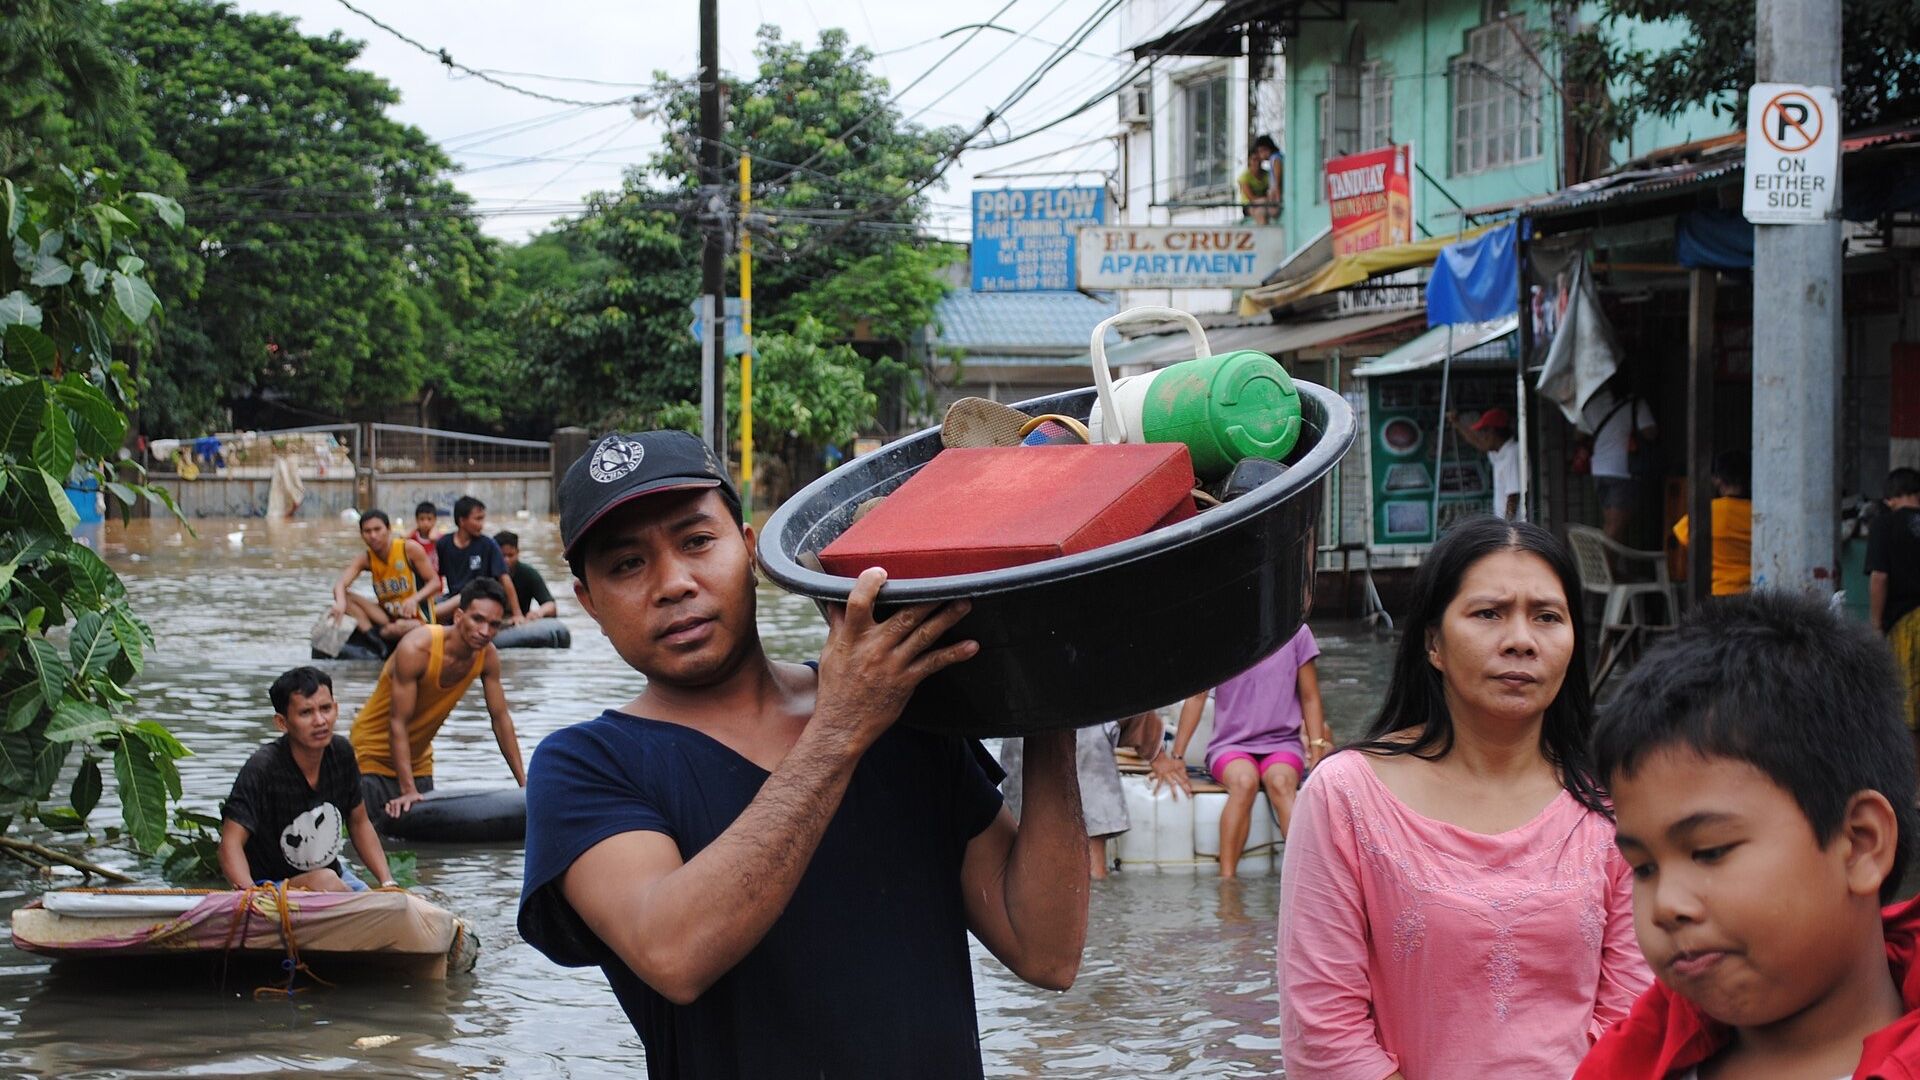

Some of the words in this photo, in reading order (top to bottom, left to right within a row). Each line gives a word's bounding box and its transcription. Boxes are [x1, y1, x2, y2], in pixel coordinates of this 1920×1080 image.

[1778, 157, 1805, 172] ON
[1329, 163, 1386, 200] TANDUAY
[1755, 174, 1825, 191] EITHER
[979, 191, 1026, 220] PRO
[1031, 189, 1097, 219] FLOW
[1767, 192, 1812, 208] SIDE
[1163, 231, 1255, 251] CRUZ
[1100, 253, 1257, 274] APARTMENT
